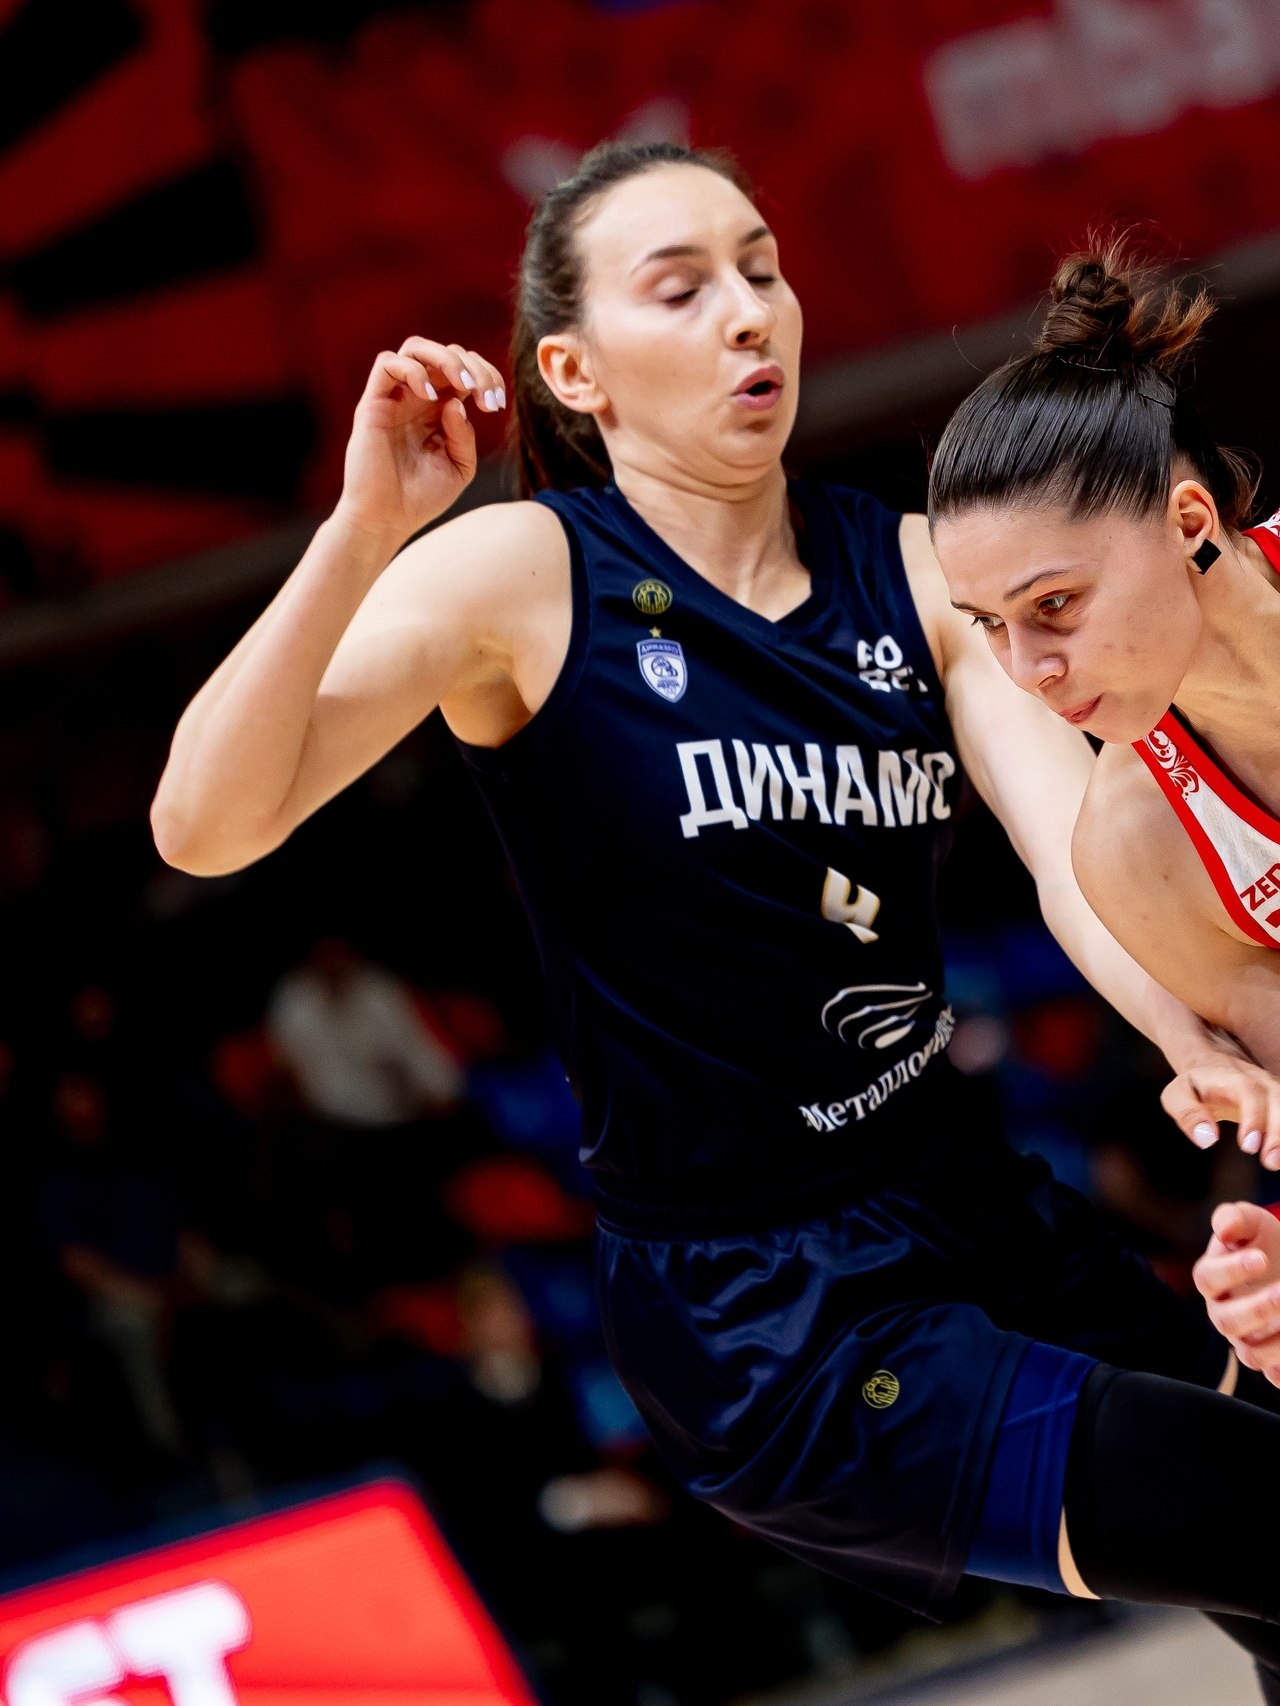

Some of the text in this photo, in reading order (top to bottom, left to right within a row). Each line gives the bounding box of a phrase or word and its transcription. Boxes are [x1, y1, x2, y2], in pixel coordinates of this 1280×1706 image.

[857, 634, 903, 670] FO
[859, 666, 929, 693] BE
[675, 738, 956, 839] ДИНАМО
